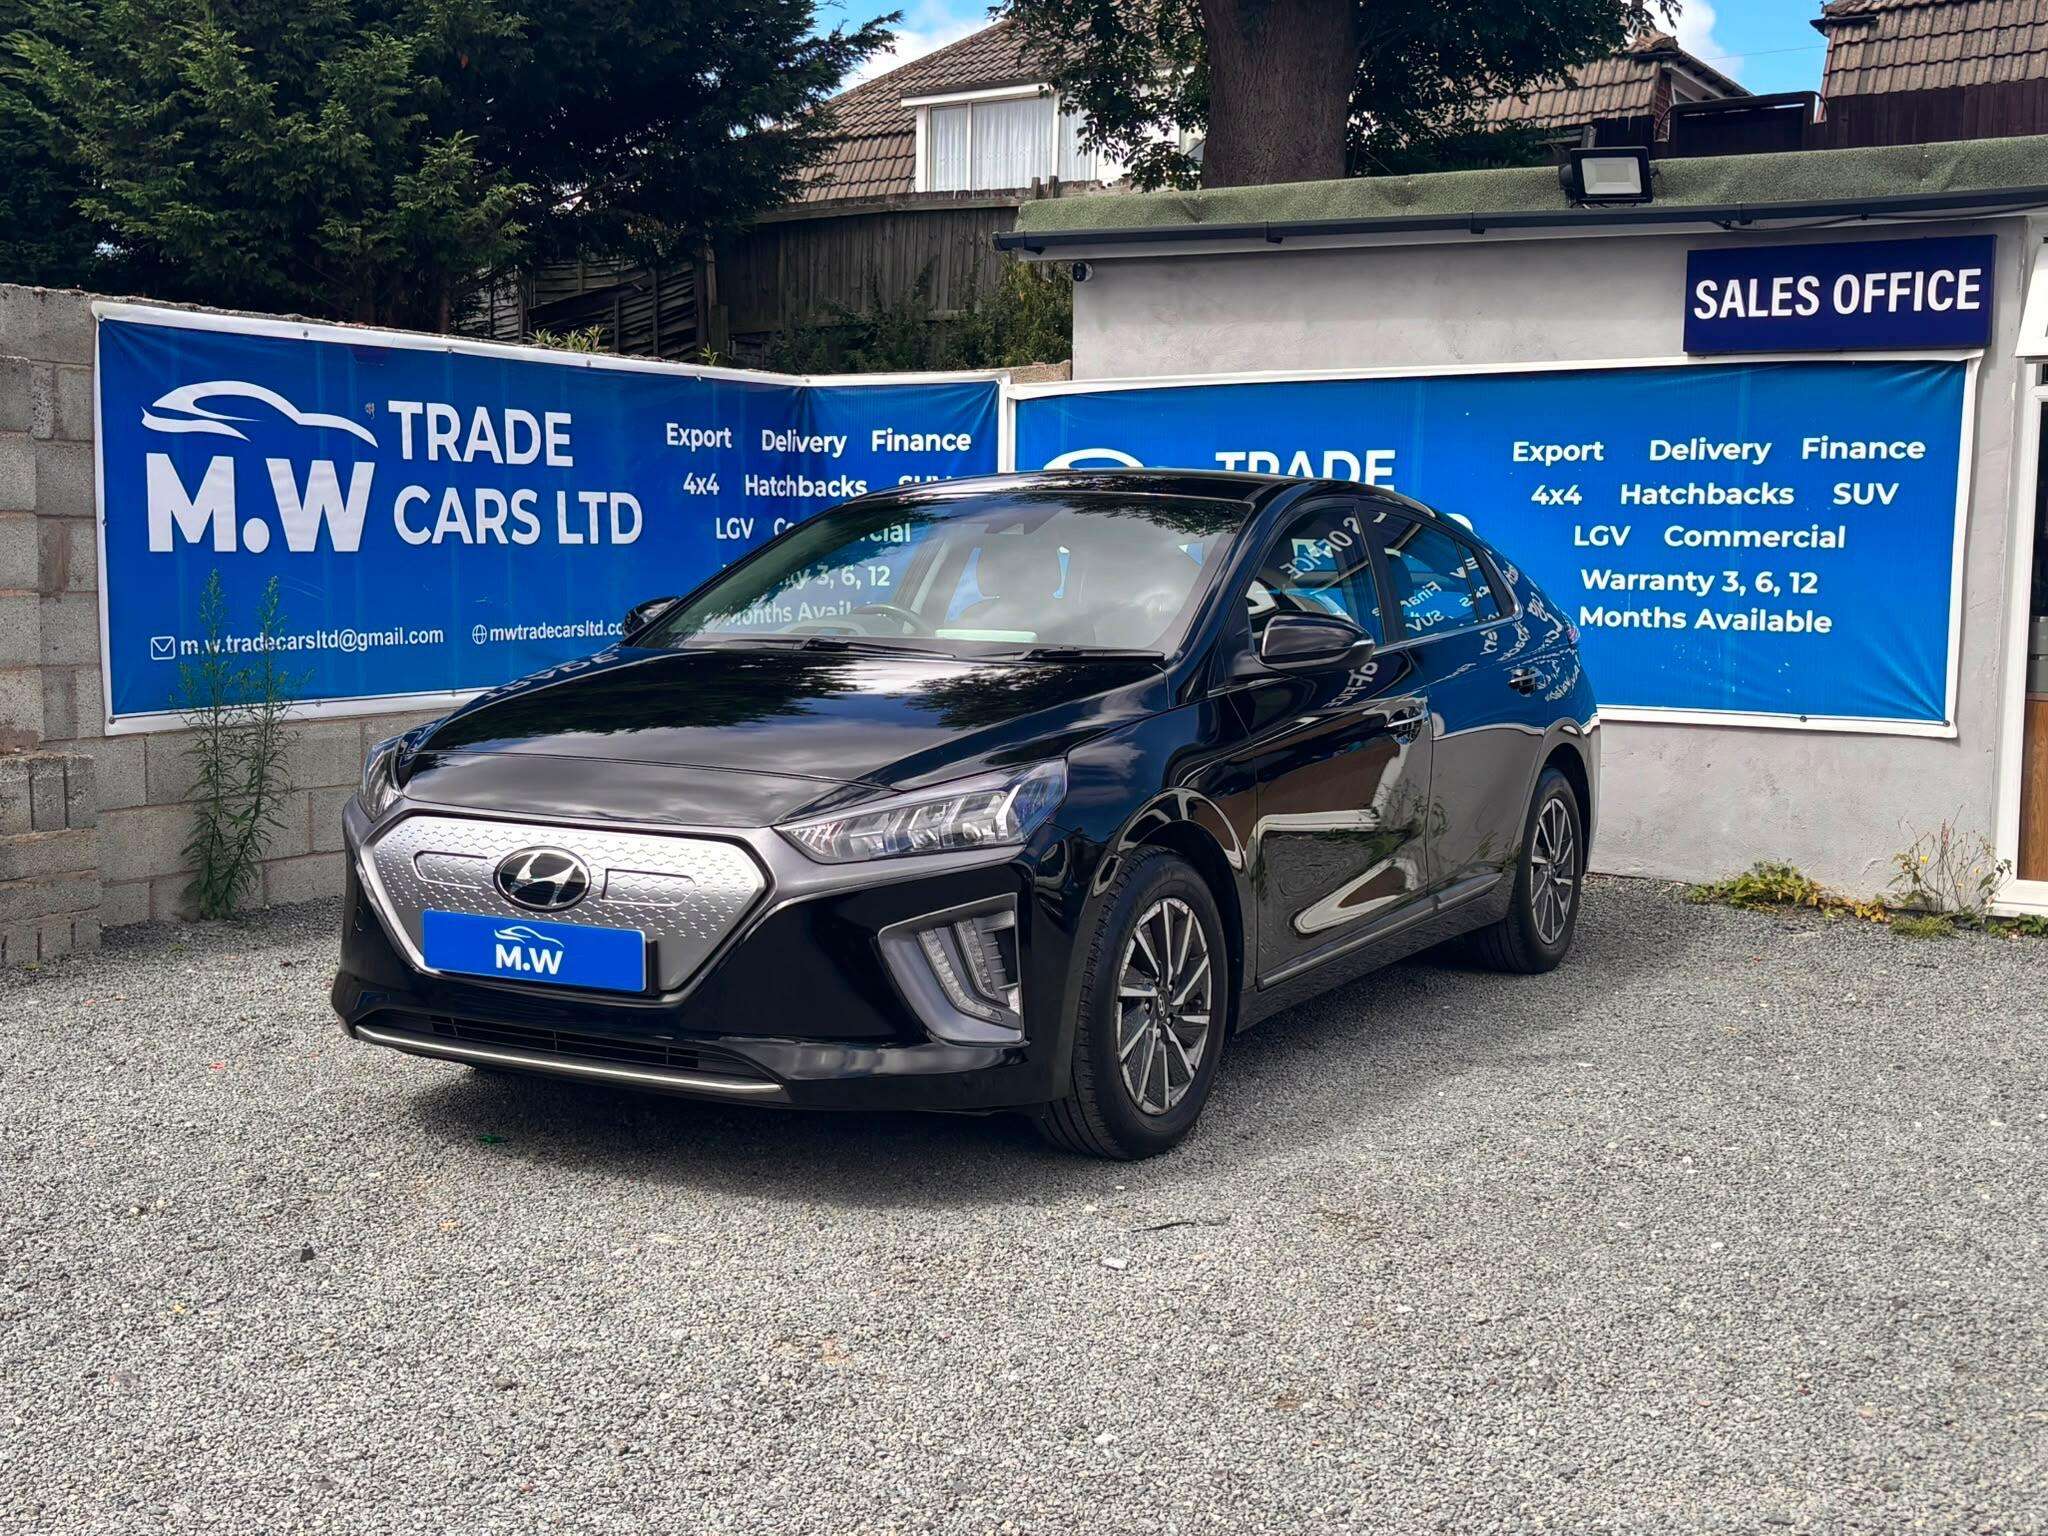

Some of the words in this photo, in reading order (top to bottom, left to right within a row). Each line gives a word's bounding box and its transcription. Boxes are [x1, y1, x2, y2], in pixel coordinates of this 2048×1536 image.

[1693, 275, 1820, 320] SALES
[1833, 268, 1982, 315] OFFICE
[387, 400, 574, 467] TRADE
[665, 422, 732, 452] Export
[761, 429, 848, 458] Delivery
[871, 428, 972, 452] Finance
[1512, 441, 1604, 467] Export
[1649, 438, 1772, 465] Delivery
[1802, 435, 1926, 460] Finance
[683, 473, 720, 496] 4x4
[744, 472, 868, 498] Hatchbacks
[1530, 484, 1583, 505] 4x4
[1620, 482, 1795, 505] Hatchbacks
[1832, 482, 1899, 506] SUV
[146, 452, 375, 553] M.W
[393, 485, 541, 545] CARS
[556, 490, 643, 545] LTD
[716, 517, 754, 540] LGV
[1574, 525, 1631, 547] LGV
[1664, 524, 1846, 549] Commercial
[841, 565, 861, 590] 6,
[867, 566, 891, 587] 12
[1581, 569, 1716, 597] Warranty
[1721, 570, 1747, 597] 3,
[1754, 571, 1785, 597] 6,
[1789, 571, 1818, 594] 12
[1578, 606, 1687, 630] Months
[1694, 607, 1832, 634] Available
[180, 627, 444, 655] m.w.tradecarsltd@gmail.com
[494, 943, 563, 975] M.W
